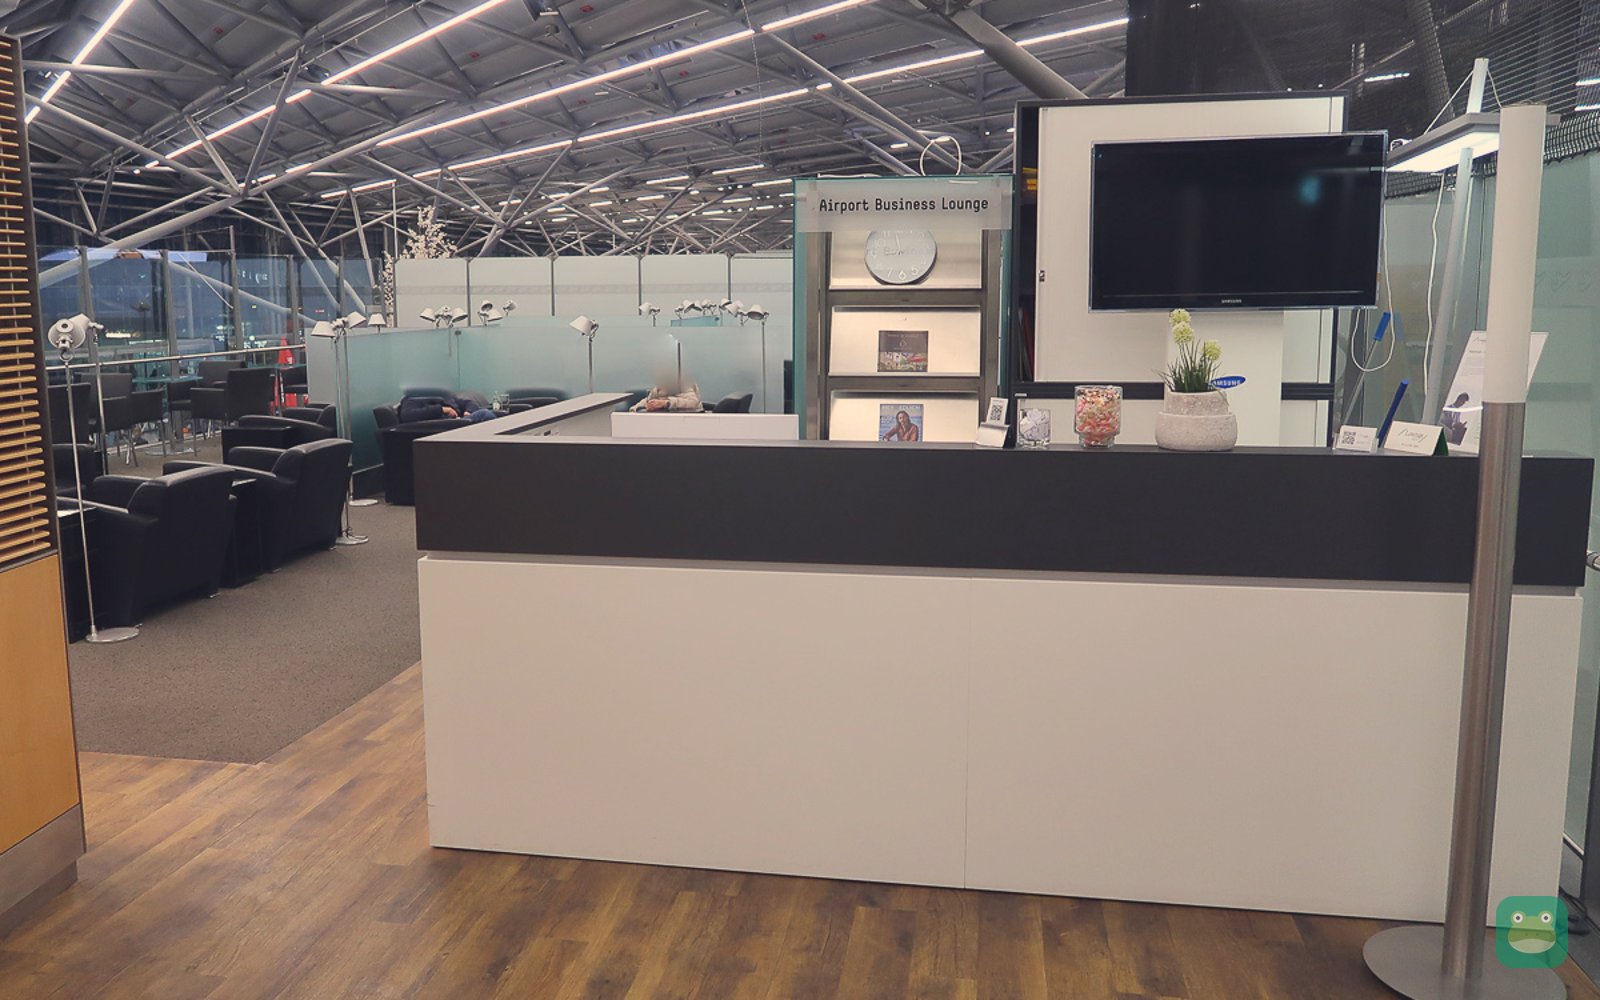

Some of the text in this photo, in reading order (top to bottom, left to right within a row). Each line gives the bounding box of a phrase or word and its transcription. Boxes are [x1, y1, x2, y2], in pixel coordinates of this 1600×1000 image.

[819, 197, 989, 214] Airport Business Lounge
[1212, 379, 1241, 387] AMSUNG
